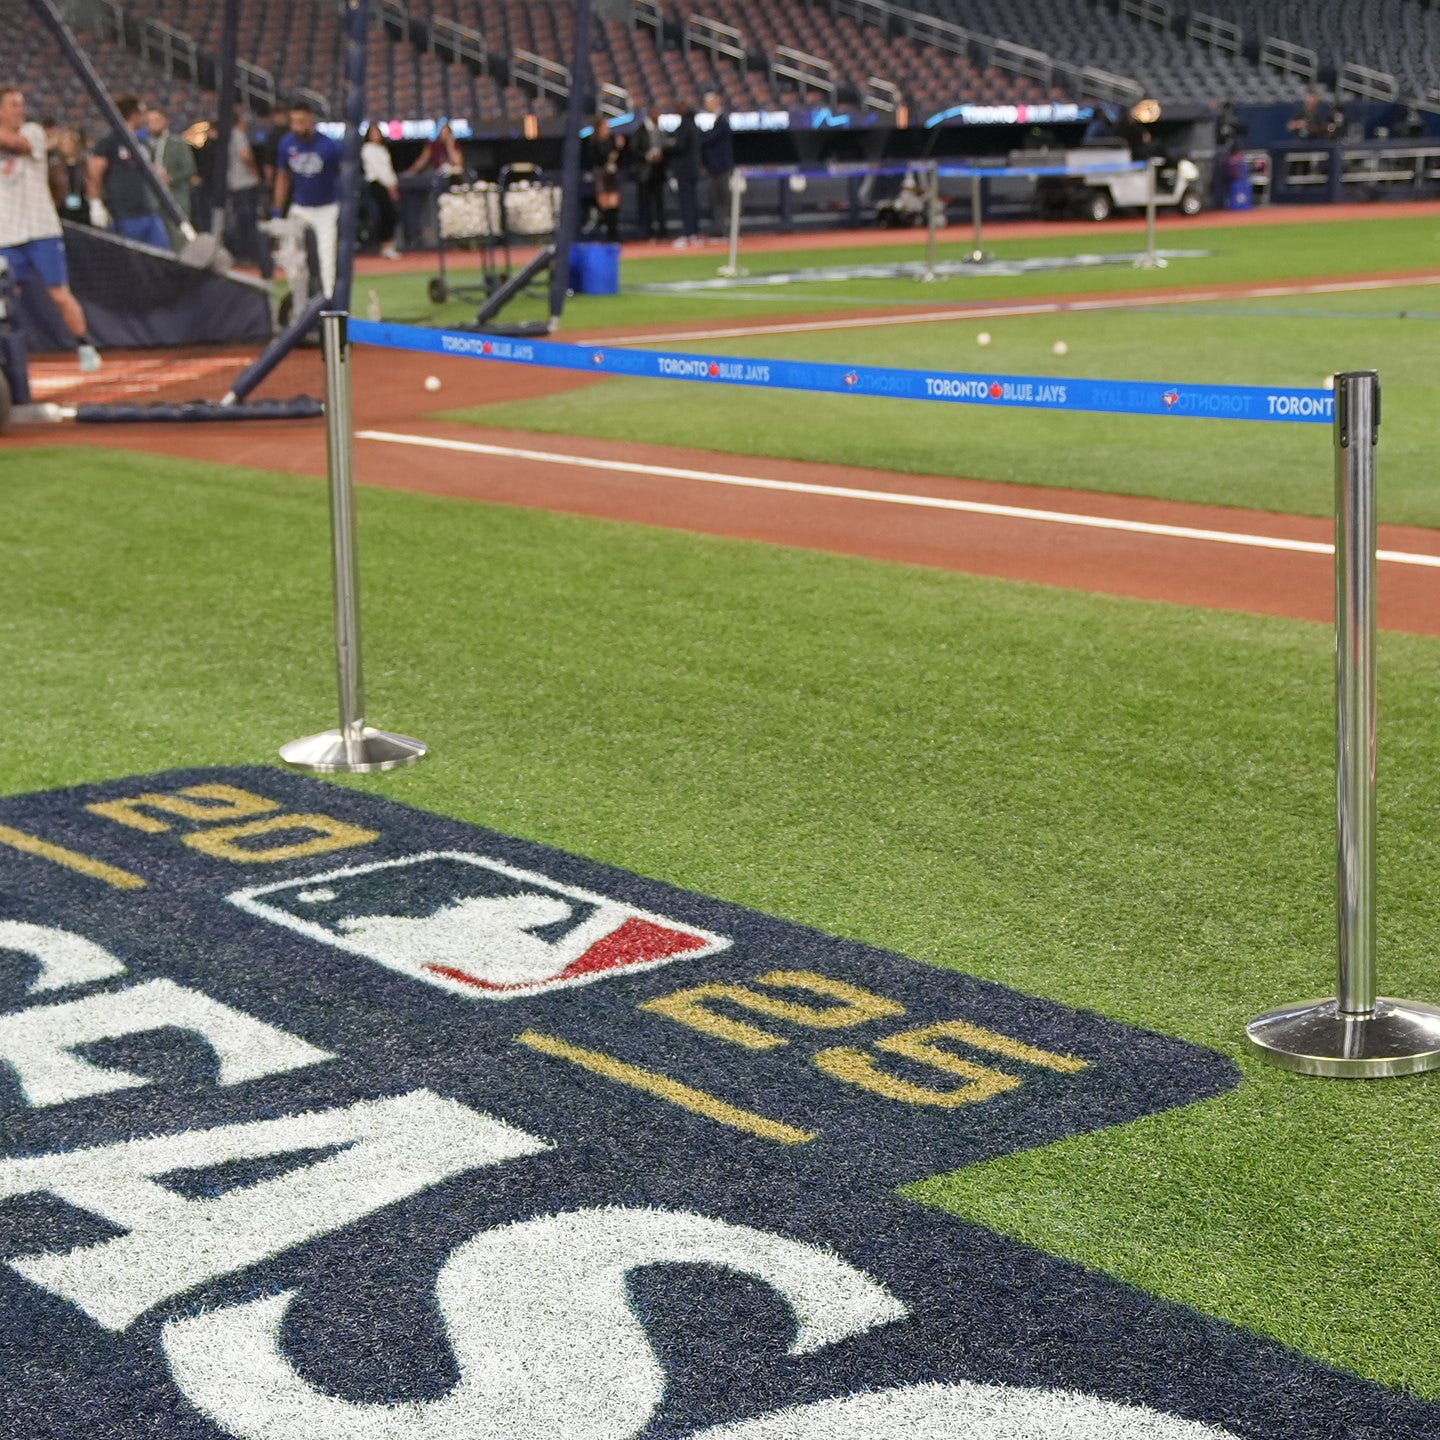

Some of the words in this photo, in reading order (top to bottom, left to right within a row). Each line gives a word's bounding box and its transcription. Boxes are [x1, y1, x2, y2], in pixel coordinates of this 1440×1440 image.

[441, 335, 483, 355] TORONTO
[657, 357, 709, 377] TORONTO
[719, 363, 743, 380] BLUE
[744, 365, 770, 383] JAYS
[925, 378, 988, 400] TORONTO
[1003, 384, 1033, 402] BLUE
[1035, 385, 1067, 403] JAYS
[1266, 395, 1334, 416] TORONT
[88, 783, 378, 864] 20
[643, 970, 1088, 1109] 25
